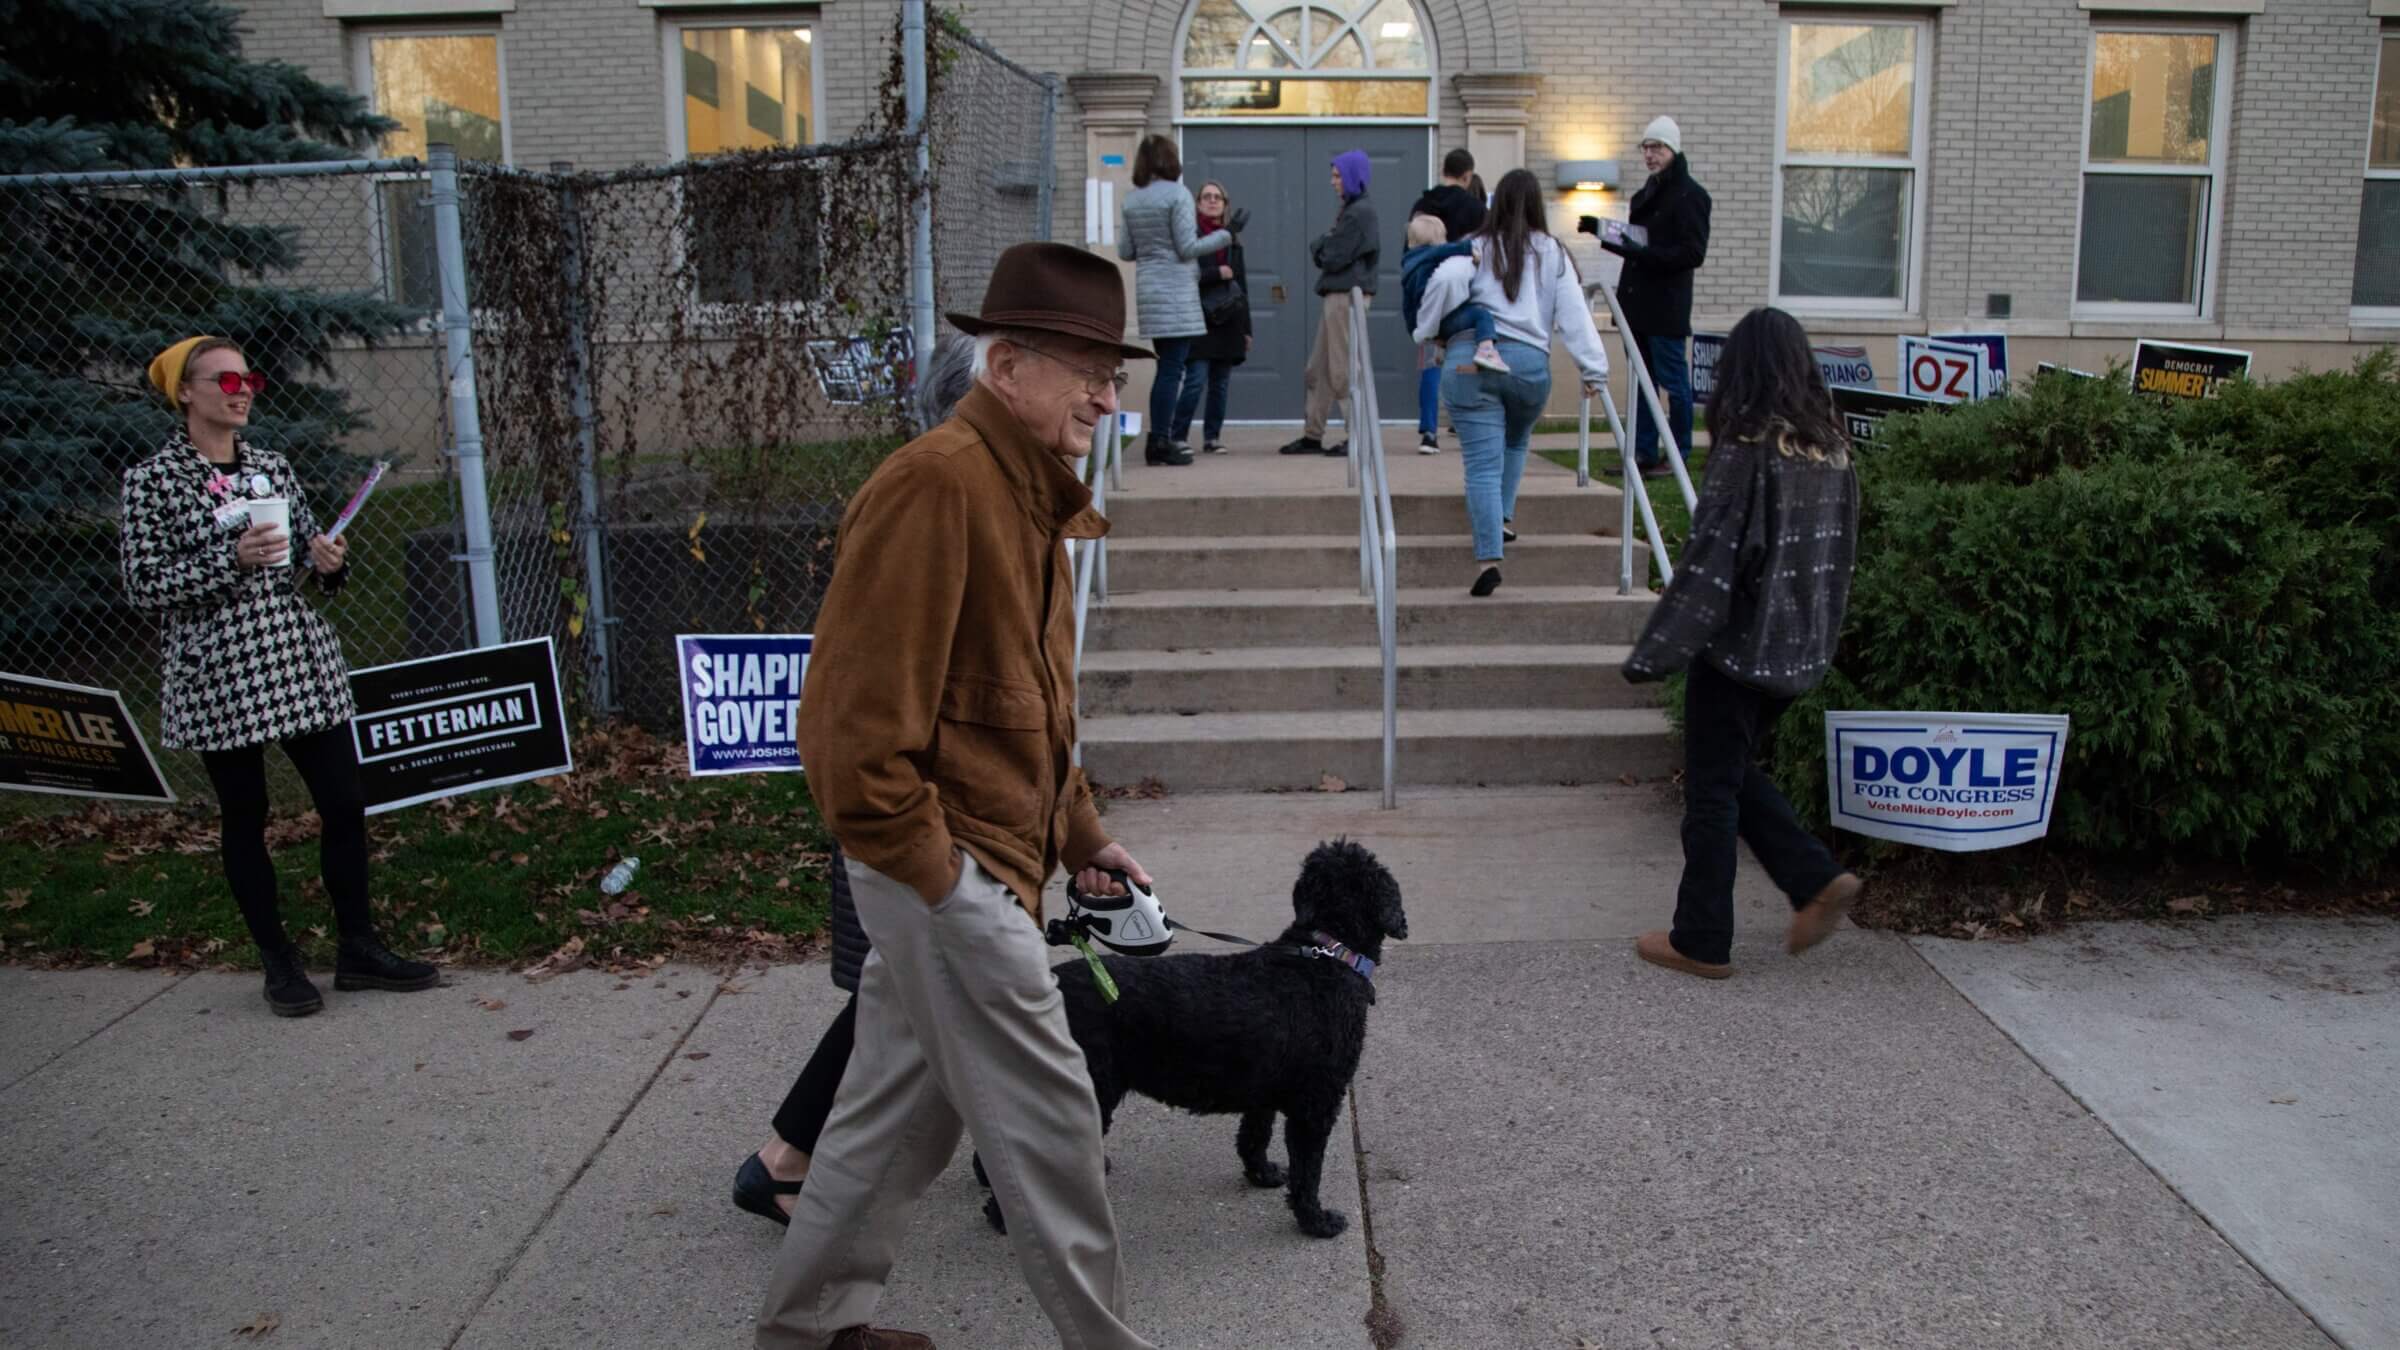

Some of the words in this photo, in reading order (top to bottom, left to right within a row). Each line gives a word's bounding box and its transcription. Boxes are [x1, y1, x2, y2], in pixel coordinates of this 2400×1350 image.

[1913, 355, 1969, 398] OZ
[2164, 359, 2214, 374] DEMOCRAT
[2138, 367, 2205, 399] SUMMER
[62, 709, 127, 749] LEE
[369, 696, 524, 750] FETTERMAN
[16, 736, 117, 764] CONGRESS
[411, 754, 444, 768] SENATE
[454, 740, 517, 759] PENNSYLVANIA
[1853, 746, 2039, 787] DOYLE
[1853, 783, 1901, 799] FOR
[1907, 786, 2035, 804] CONGRESS
[1867, 800, 2014, 819] VoteMikeDoyle.com
